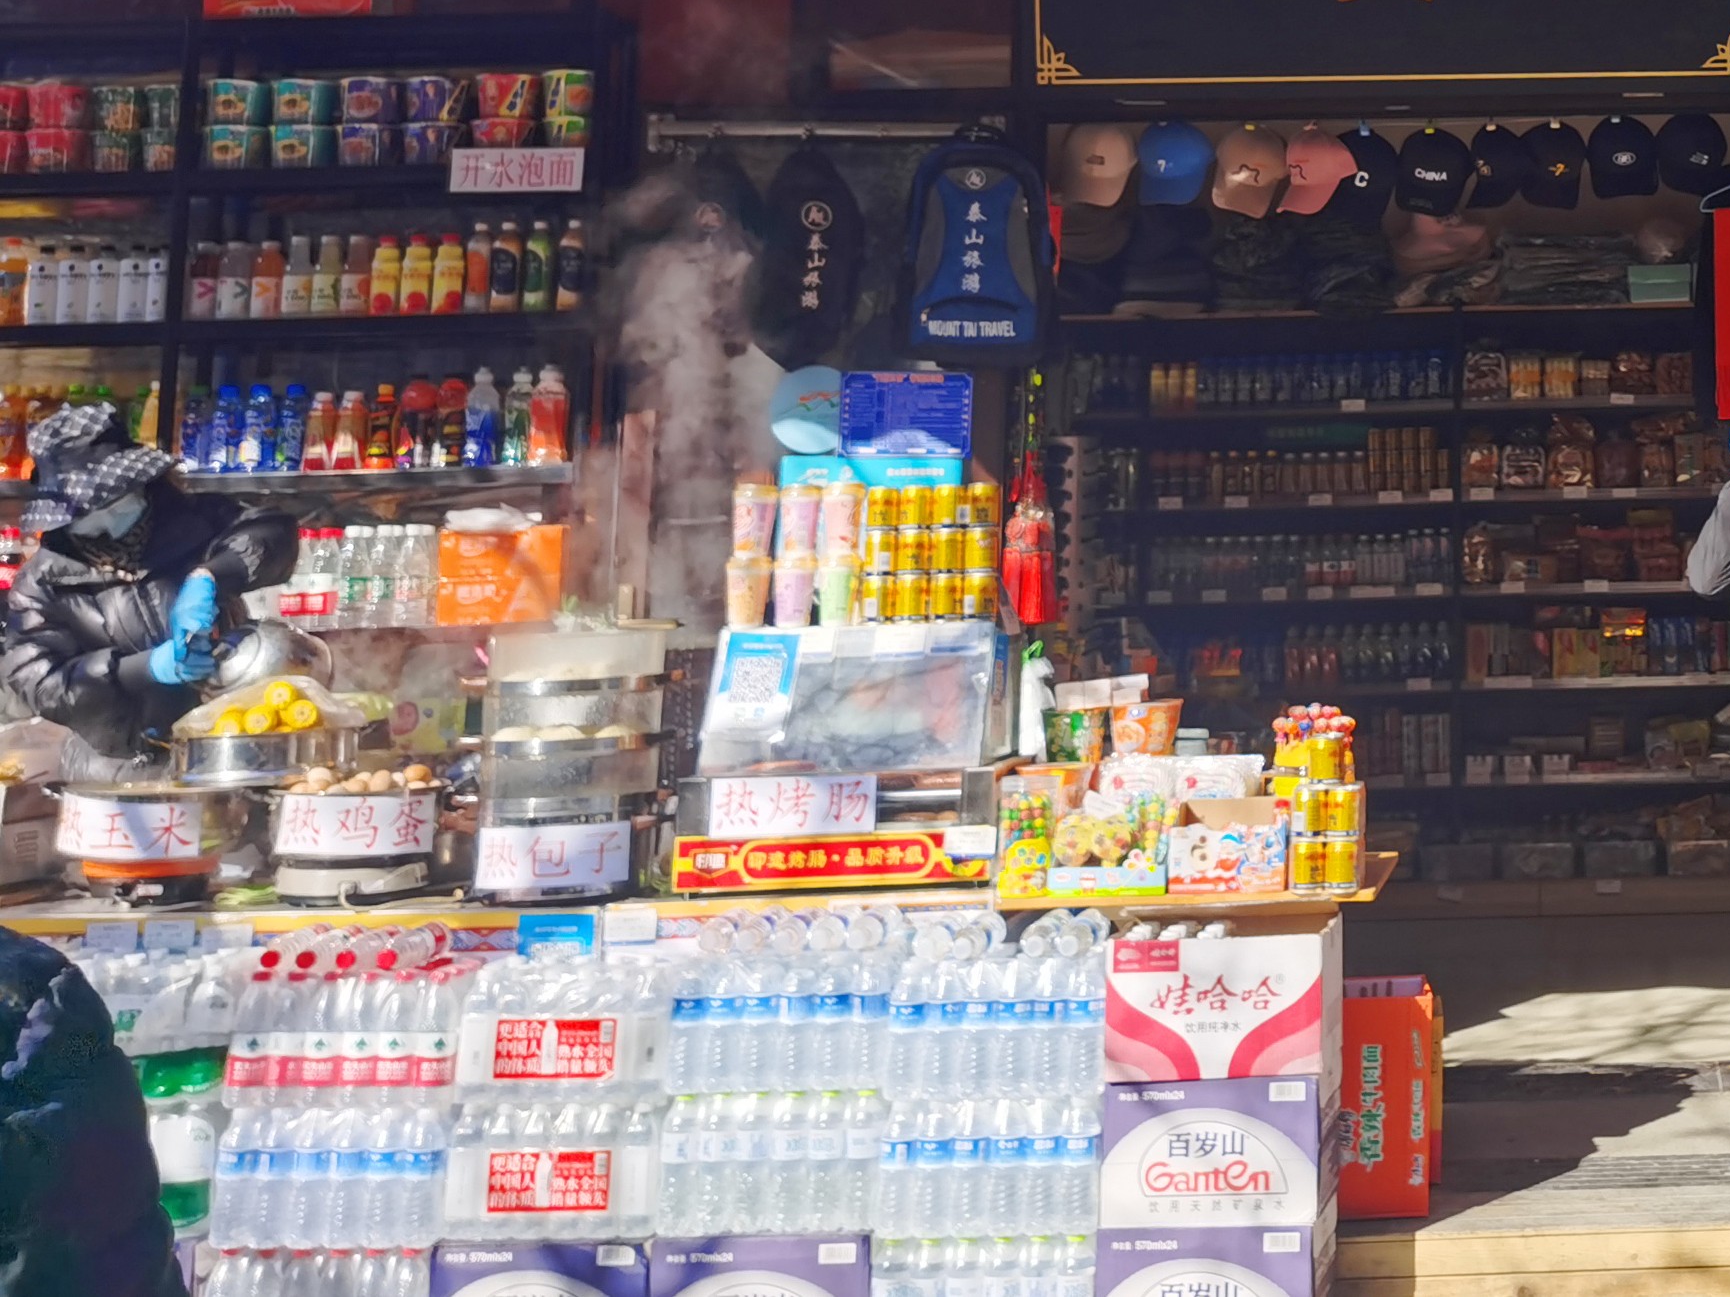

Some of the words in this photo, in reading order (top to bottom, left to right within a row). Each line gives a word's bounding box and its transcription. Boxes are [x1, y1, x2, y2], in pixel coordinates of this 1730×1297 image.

[459, 152, 577, 188] 开水泡面
[1414, 167, 1448, 182] CHINA
[980, 320, 1016, 337] TRAVEL
[283, 795, 427, 849] 热鸡蛋
[715, 779, 870, 829] 热烤肠
[62, 803, 194, 857] 热玉米
[482, 830, 624, 879] 热包子
[1150, 974, 1282, 1015] 娃哈哈
[1360, 1044, 1382, 1166] 香辣牛肉面
[1168, 1131, 1246, 1159] 百岁山
[1145, 1160, 1271, 1193] Ganten
